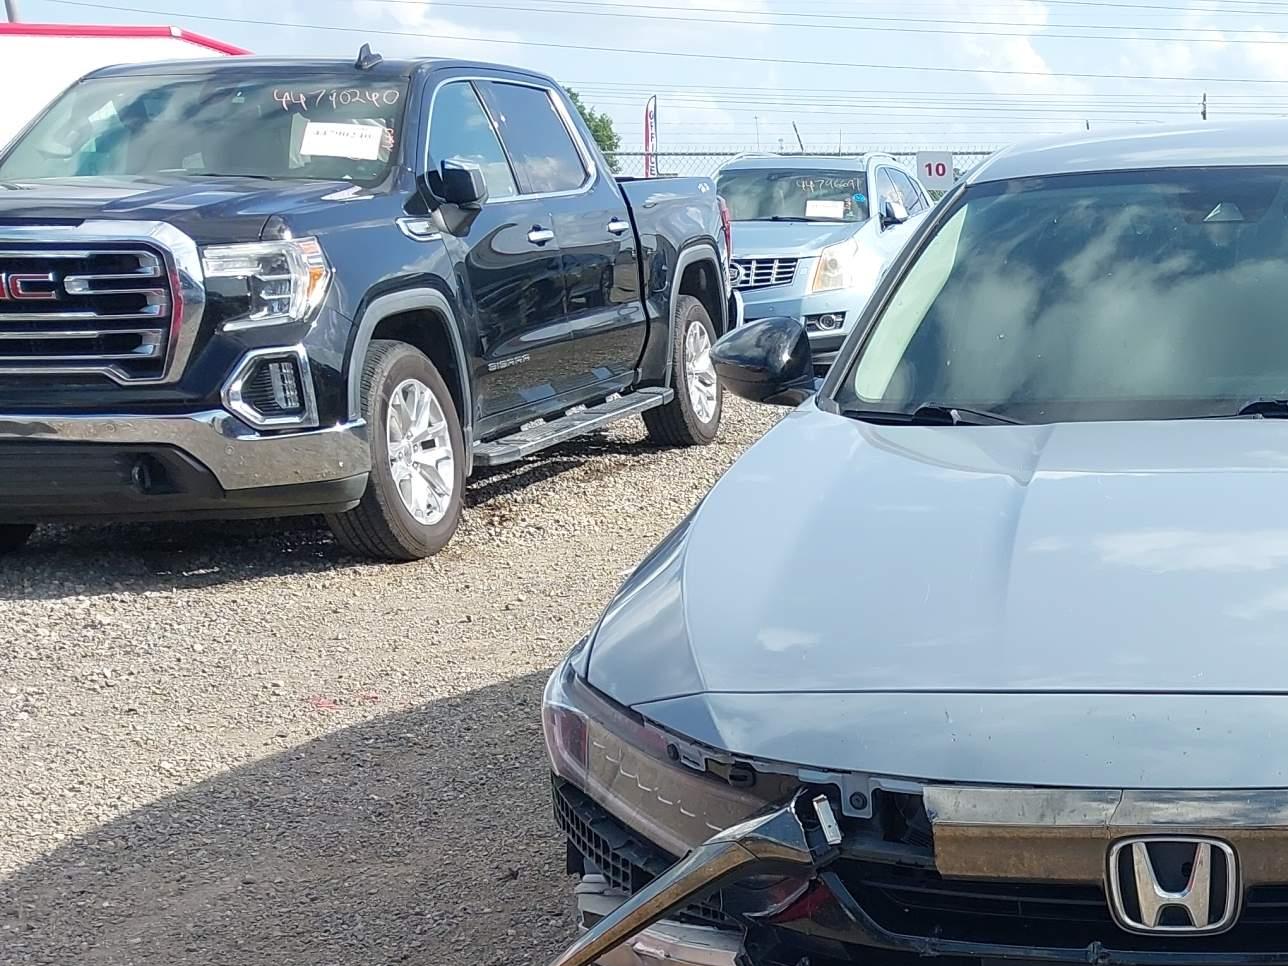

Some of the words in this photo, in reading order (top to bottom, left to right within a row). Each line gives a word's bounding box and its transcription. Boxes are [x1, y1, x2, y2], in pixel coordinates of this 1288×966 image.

[273, 88, 400, 112] 44790240
[648, 110, 656, 176] OFFICE
[924, 163, 946, 177] 10
